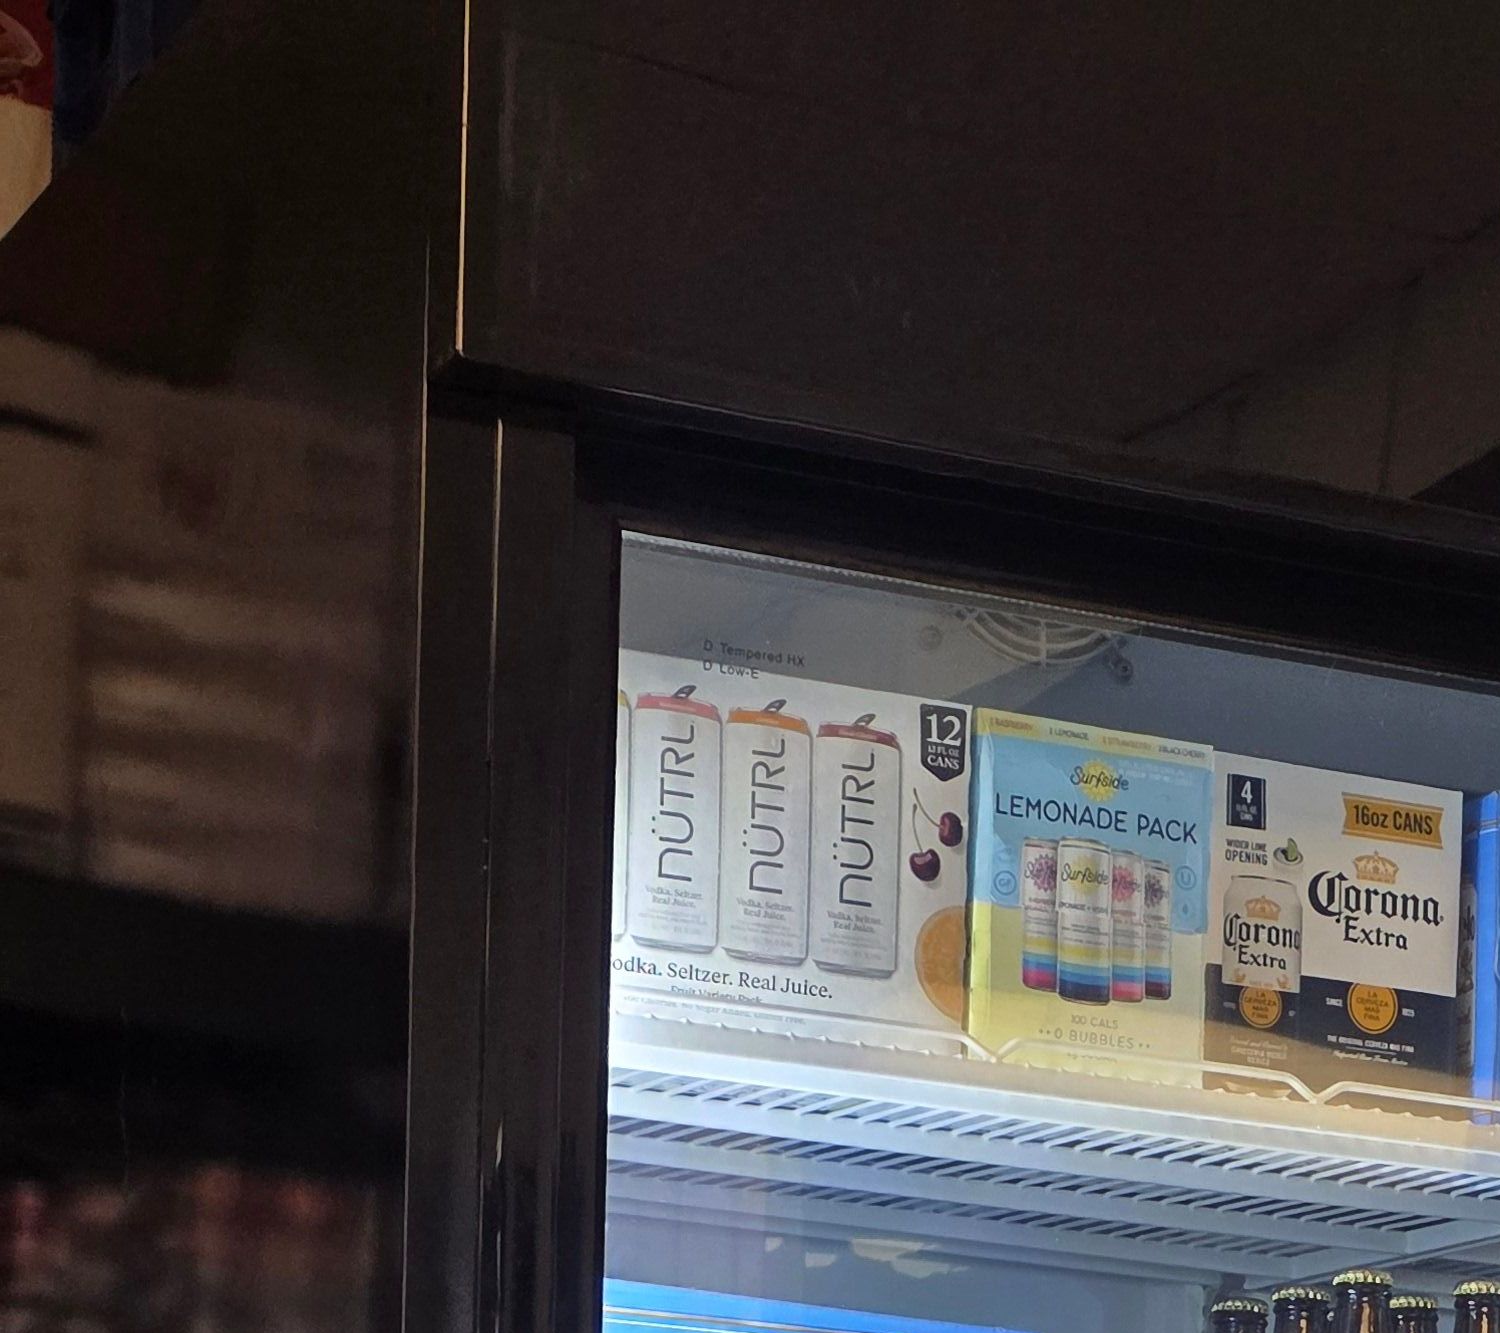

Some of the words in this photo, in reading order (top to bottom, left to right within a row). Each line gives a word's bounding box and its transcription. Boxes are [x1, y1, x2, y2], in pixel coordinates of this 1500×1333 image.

[720, 641, 783, 663] Tempered
[787, 654, 806, 668] HX
[720, 662, 760, 680] Low-E
[924, 714, 962, 746] 12
[926, 755, 960, 770] CANS
[1069, 765, 1129, 792] Surfside
[1240, 780, 1254, 804] 4
[994, 792, 1128, 834] LEMONADE
[1136, 813, 1198, 845] PACK
[1352, 803, 1388, 830] 16oz
[1391, 809, 1434, 836] CANS
[1224, 849, 1269, 866] OPENING
[1307, 869, 1445, 928] Corona
[1222, 913, 1301, 950] Corona
[1342, 915, 1409, 951] Extra
[1236, 944, 1287, 971] Extra
[612, 955, 662, 977] odka.
[667, 963, 734, 987] Seltzer.
[739, 972, 777, 992] Real
[780, 976, 834, 1000] Juice.
